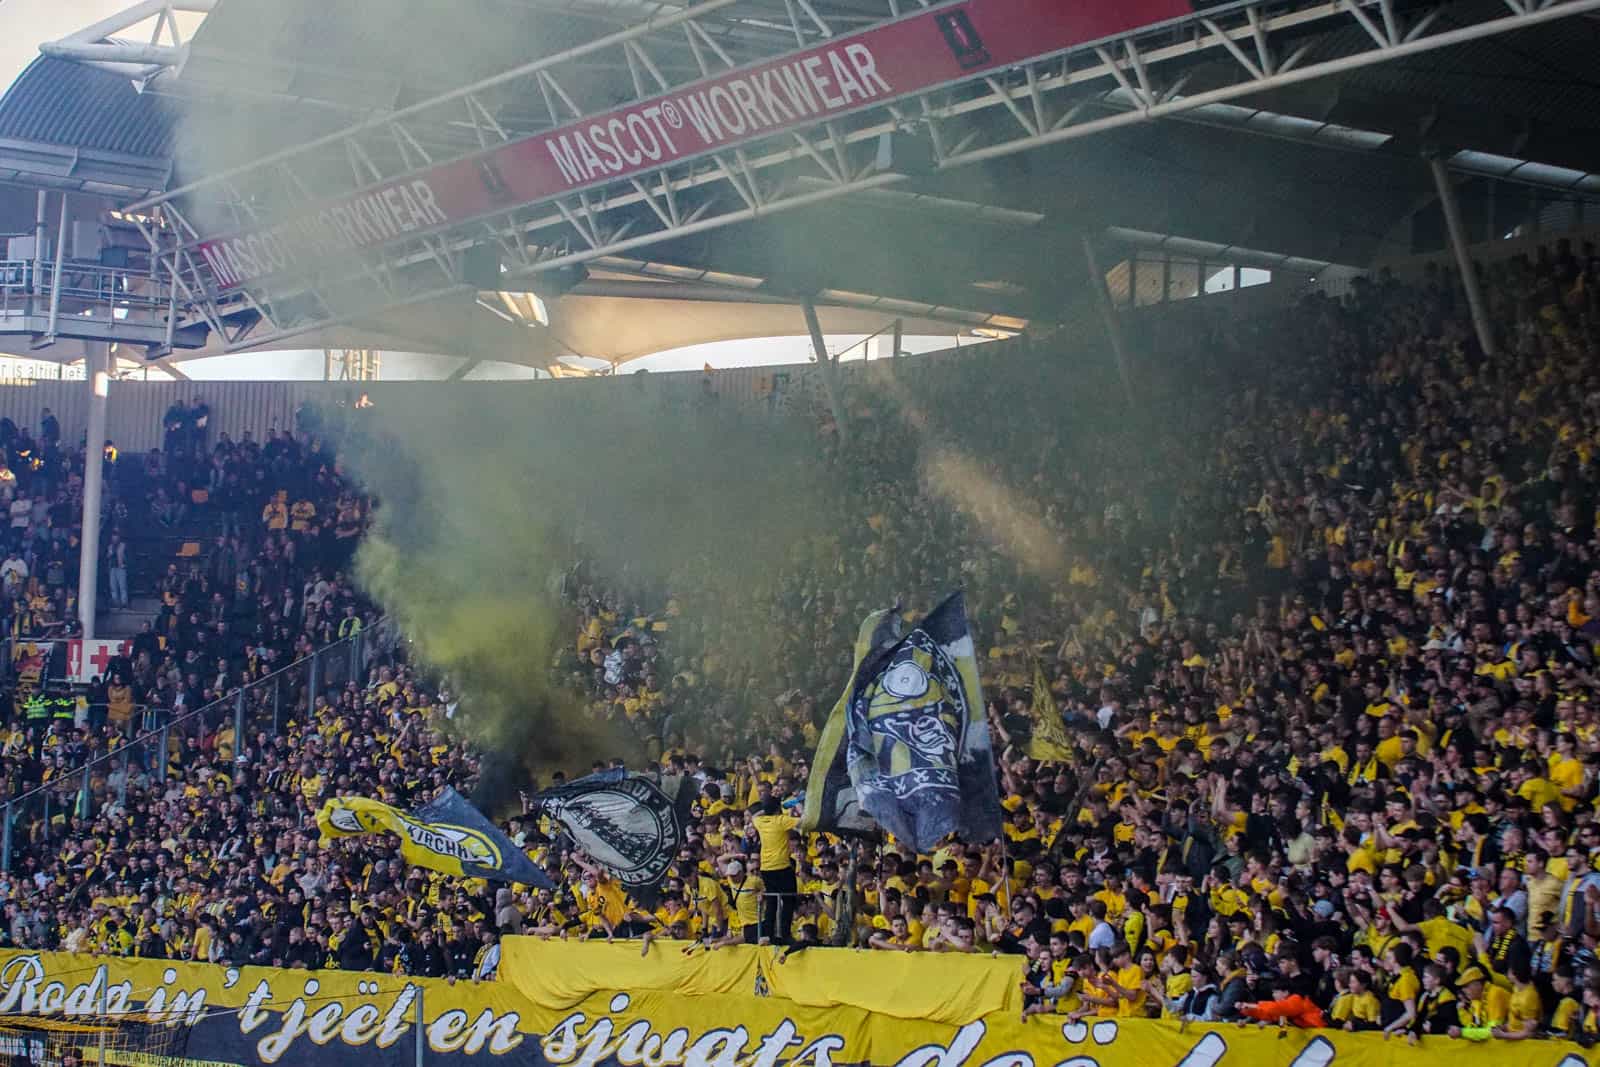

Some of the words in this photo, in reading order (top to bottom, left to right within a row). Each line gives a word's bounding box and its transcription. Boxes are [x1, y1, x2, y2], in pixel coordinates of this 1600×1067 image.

[678, 43, 892, 145] WORKWEAR
[1, 954, 133, 1019] Roda
[146, 968, 208, 1027] in
[257, 978, 420, 1063] jeël
[426, 1008, 523, 1055] en
